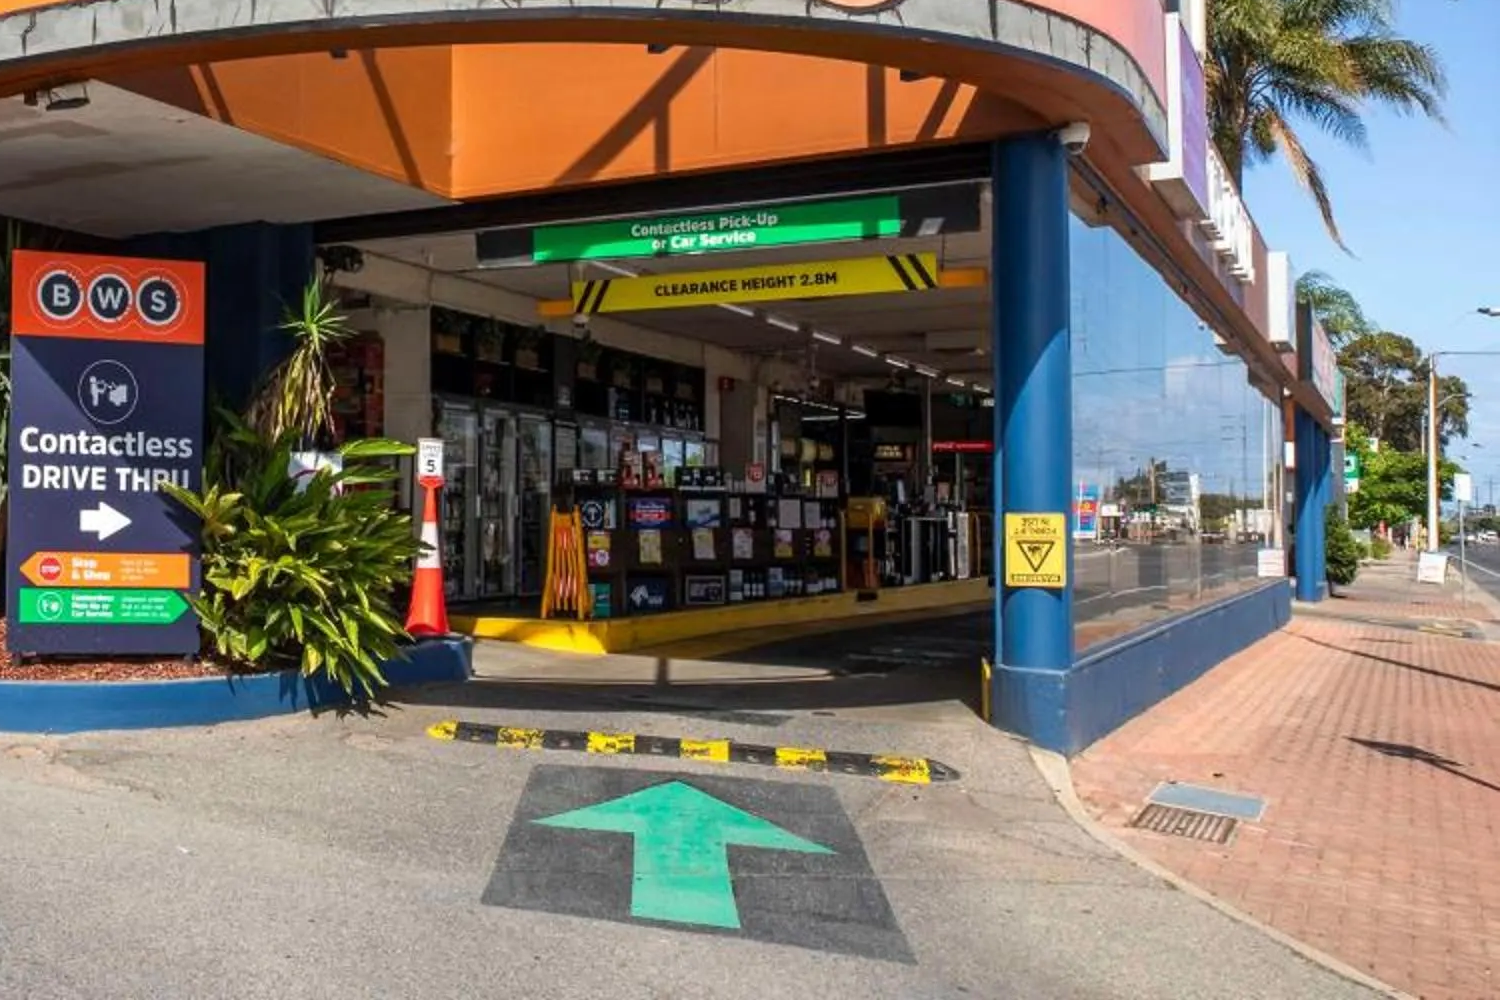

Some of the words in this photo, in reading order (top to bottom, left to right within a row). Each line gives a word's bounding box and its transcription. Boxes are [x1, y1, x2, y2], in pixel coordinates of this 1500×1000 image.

[631, 219, 715, 237] Contactless
[719, 213, 778, 229] Pick-Up
[652, 238, 667, 250] or
[670, 235, 696, 249] Car
[700, 231, 757, 247] Service
[655, 279, 737, 297] CLEARANCE
[741, 275, 796, 291] HEIGHT
[801, 271, 837, 287] 2.8M
[53, 283, 168, 313] BWS
[19, 426, 193, 458] Contactless
[22, 463, 107, 491] DRIVE
[426, 459, 436, 473] 5
